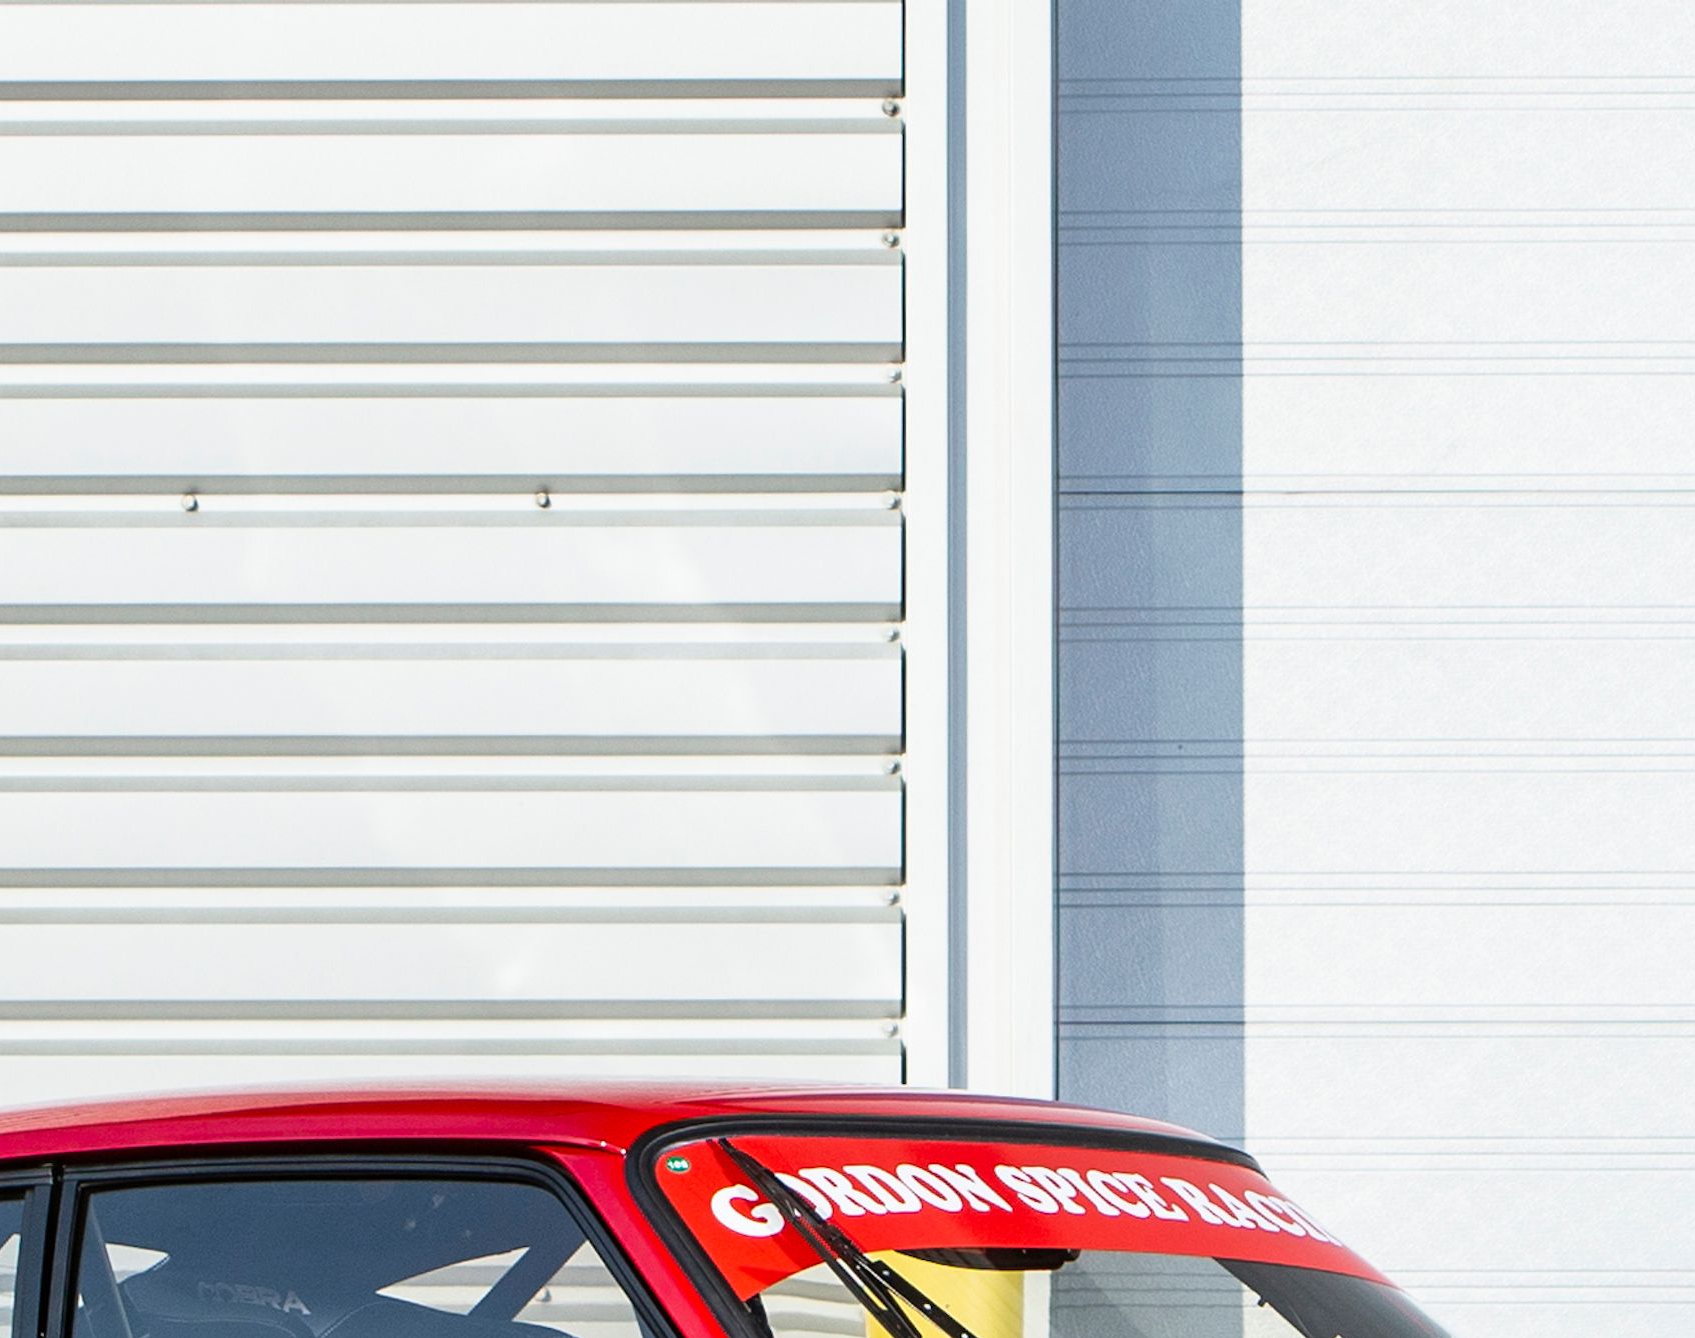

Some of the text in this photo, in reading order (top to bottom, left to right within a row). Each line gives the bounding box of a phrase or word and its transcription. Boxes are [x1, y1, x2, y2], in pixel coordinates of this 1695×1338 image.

[993, 1165, 1189, 1222] SPICE
[1159, 1176, 1345, 1248] RACI
[197, 1281, 311, 1315] COBRA
